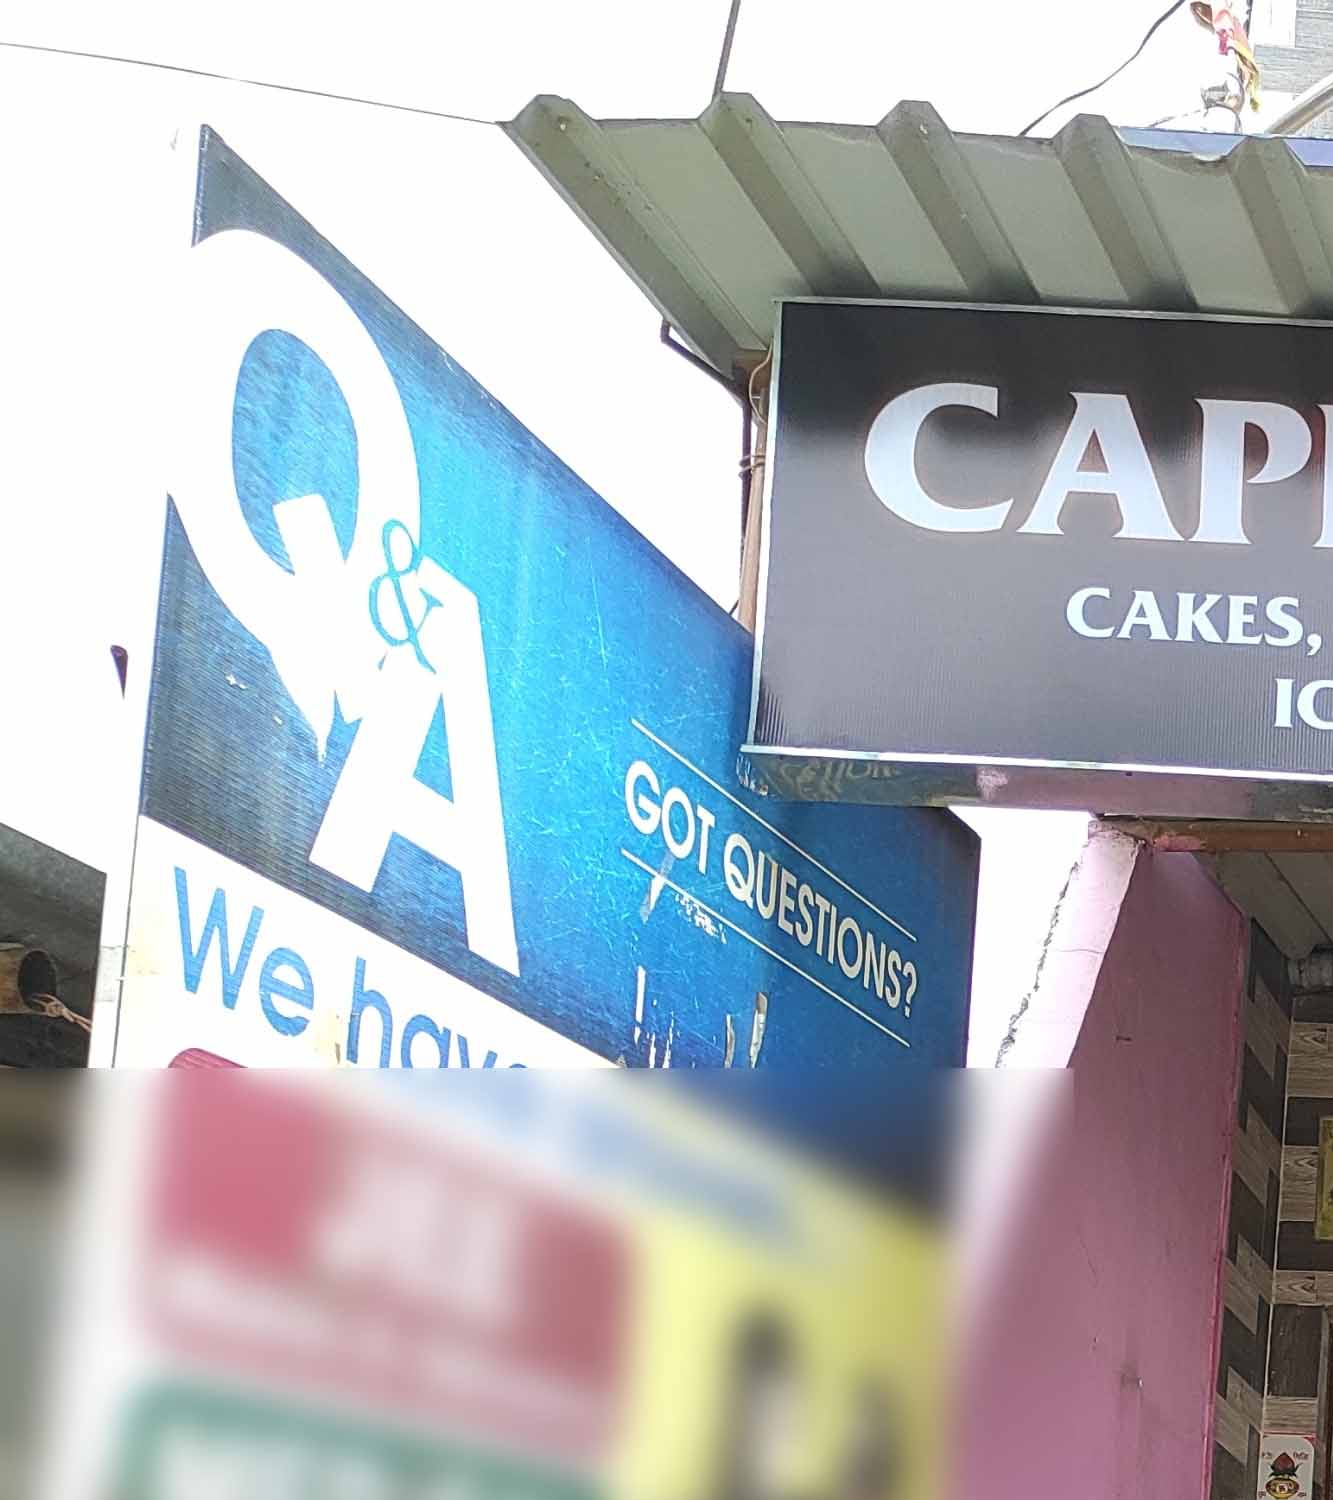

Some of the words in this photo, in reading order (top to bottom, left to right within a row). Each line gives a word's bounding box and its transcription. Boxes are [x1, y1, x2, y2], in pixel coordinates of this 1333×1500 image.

[1066, 586, 1322, 656] CAKES,
[174, 866, 314, 1036] We
[625, 760, 715, 874] GOT
[723, 833, 917, 1018] QUESTIONS?
